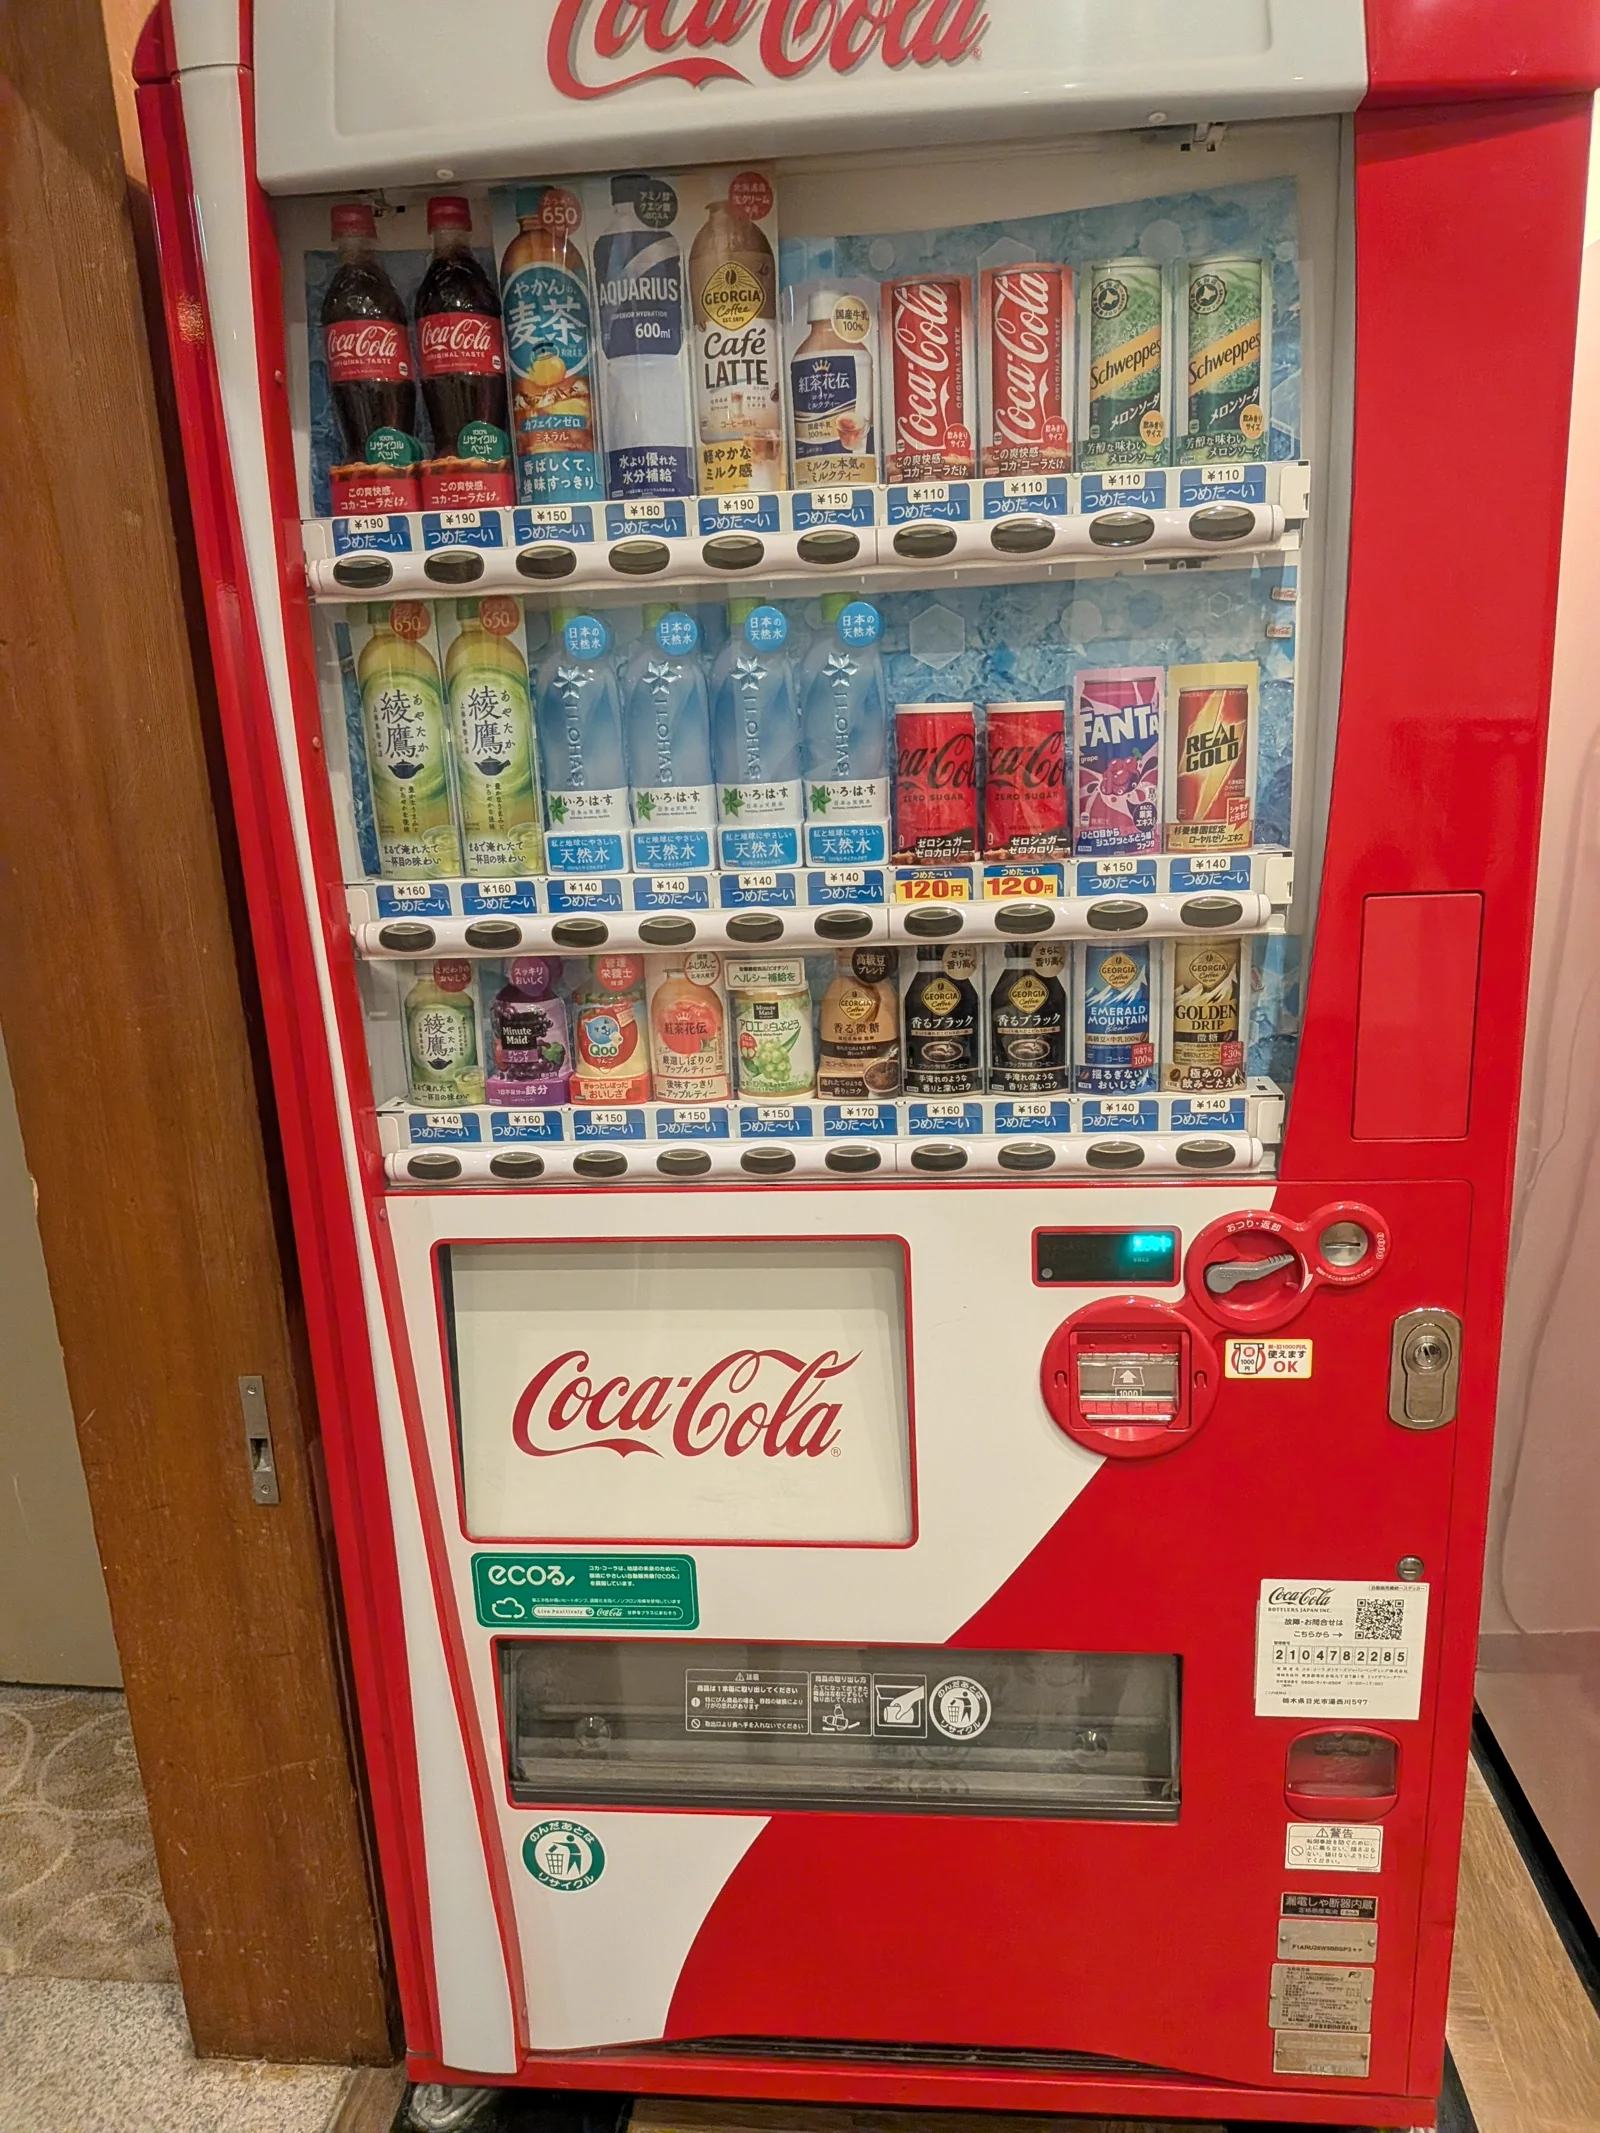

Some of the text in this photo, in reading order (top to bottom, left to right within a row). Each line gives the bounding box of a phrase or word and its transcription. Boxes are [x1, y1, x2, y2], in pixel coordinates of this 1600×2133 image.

[547, 0, 990, 100] CocaCola
[542, 207, 577, 224] 650
[600, 277, 678, 306] AQUARIUS
[705, 289, 762, 306] GEORGIA
[716, 304, 749, 318] Coffee
[836, 308, 869, 321] 国産牛乳
[508, 296, 588, 350] 麦茶
[843, 321, 864, 332] 100%
[635, 323, 670, 339] 600ml
[422, 319, 492, 355] Coca-Cola
[328, 326, 398, 360] Coca-Cola
[703, 328, 766, 359] Café
[994, 272, 1049, 444] Coca-Cola
[894, 282, 950, 450] Coca-Cola
[1090, 338, 1162, 390] Schweppes
[705, 358, 769, 389] LATTE
[798, 372, 850, 392] 紅茶花伝
[955, 360, 963, 409] ORIGINAL
[1109, 391, 1161, 431] メロンソーダ
[525, 416, 581, 431] カフェインゼロ
[463, 435, 498, 444] リサイクル
[535, 432, 569, 443] ミネラル
[1087, 441, 1146, 455] 芳醇な味わい
[619, 453, 678, 467] 水より優れた
[704, 446, 752, 465] 軽やかな
[1109, 453, 1162, 465] メロンソーダ
[807, 457, 865, 471] ミルクに本気の
[706, 464, 753, 481] ミルク感
[812, 470, 861, 483] ミルクティー
[1207, 469, 1240, 481] ¥110
[523, 476, 594, 494] 後味すっきり
[1108, 474, 1140, 486] ¥110
[348, 486, 395, 497] この爽快感。
[1010, 481, 1043, 493] ¥110
[818, 493, 848, 504] ¥150
[913, 488, 945, 500] ¥110
[630, 505, 660, 516] ¥180
[724, 500, 754, 510] ¥190
[446, 513, 475, 525] ¥190
[537, 510, 567, 521] ¥150
[354, 518, 384, 529] ¥190
[394, 616, 421, 632] 650
[568, 627, 600, 639] 日本の
[569, 638, 601, 651] 天然水
[380, 689, 416, 759] 綾鷹
[412, 694, 429, 752] あやたか
[1080, 705, 1159, 748] FANTA
[1186, 722, 1238, 754] REAL
[1080, 755, 1098, 764] grape
[1185, 743, 1239, 773] GOLD
[1081, 828, 1119, 839] ひと口目から
[1174, 825, 1227, 835] 杉養蜂園認定
[551, 838, 618, 847] 私と地球にやさしい
[917, 837, 971, 848] ゼロシュガー
[1189, 833, 1243, 844] ローヤルゼリーエキス
[822, 837, 872, 854] 天然水
[560, 847, 610, 863] 天然水
[915, 848, 971, 858] ゼロカロリー
[385, 856, 441, 867] 一杯目の味わい
[1103, 862, 1133, 872] ¥150
[1196, 858, 1227, 869] ¥140
[743, 876, 772, 886] ¥140
[831, 872, 859, 883] ¥140
[398, 886, 425, 896] ¥160
[483, 883, 511, 894] ¥160
[569, 882, 598, 893] ¥140
[656, 880, 685, 891] ¥140
[900, 880, 963, 898] 120円
[987, 876, 1053, 896] 120円
[950, 949, 971, 957] さらに
[856, 954, 886, 967] 高級豆
[946, 959, 976, 970] 香り高く
[514, 967, 543, 976] スッキリ
[858, 966, 884, 975] ブレンド
[1101, 966, 1136, 974] GEORGIA
[515, 976, 543, 985] おいしく
[734, 972, 796, 983] ヘルシー補給を
[924, 992, 958, 1001] GEORGIA
[1091, 1005, 1146, 1016] EMERALD
[1175, 1004, 1238, 1020] GOLDEN
[911, 1015, 974, 1029] 香るブラック
[1087, 1014, 1148, 1025] MOUNTAIN
[502, 1026, 532, 1036] Minute
[664, 1022, 708, 1035] 紅茶花伝
[834, 1022, 879, 1034] 香る微糖
[1191, 1020, 1224, 1031] DRIP
[424, 1013, 447, 1057] 綾鷹
[506, 1035, 529, 1045] Maid
[590, 1045, 618, 1056] Qoo
[1092, 1069, 1142, 1079] 揺るぎない
[1189, 1067, 1222, 1077] 極みの
[666, 1079, 714, 1088] 後味すっきり
[919, 1075, 967, 1083] 手淹れのような
[1097, 1080, 1138, 1089] おいしさ
[1182, 1078, 1234, 1089] 飲みごたえ
[834, 1086, 861, 1095] 香りとコク
[922, 1083, 972, 1092] 香りと深いコク
[589, 1089, 623, 1099] おいしさ
[666, 1089, 716, 1098] アップルティー
[1018, 1105, 1046, 1114] ¥160
[1106, 1104, 1134, 1112] ¥140
[1196, 1100, 1225, 1109] ¥140
[679, 1111, 706, 1120] ¥150
[763, 1109, 790, 1118] ¥150
[847, 1108, 874, 1117] ¥170
[932, 1106, 960, 1115] ¥160
[432, 1116, 459, 1125] ¥140
[514, 1115, 540, 1124] ¥160
[595, 1114, 623, 1122] ¥150
[1226, 1219, 1282, 1232] おつり・返却
[1274, 1361, 1298, 1372] OK
[512, 1349, 864, 1459] Coca-Cola
[1268, 1587, 1335, 1606] Coca-Cola
[1284, 1618, 1343, 1626] 故障・お問合せは
[937, 1680, 983, 1700] のんだあとは
[940, 1720, 981, 1735] リサイクル
[530, 1822, 595, 1844] のんだあとは
[1330, 1828, 1353, 1839] 警告
[539, 1872, 594, 1889] リサイクル
[1285, 1896, 1373, 1910] 漏電しゃ断器内蔵
